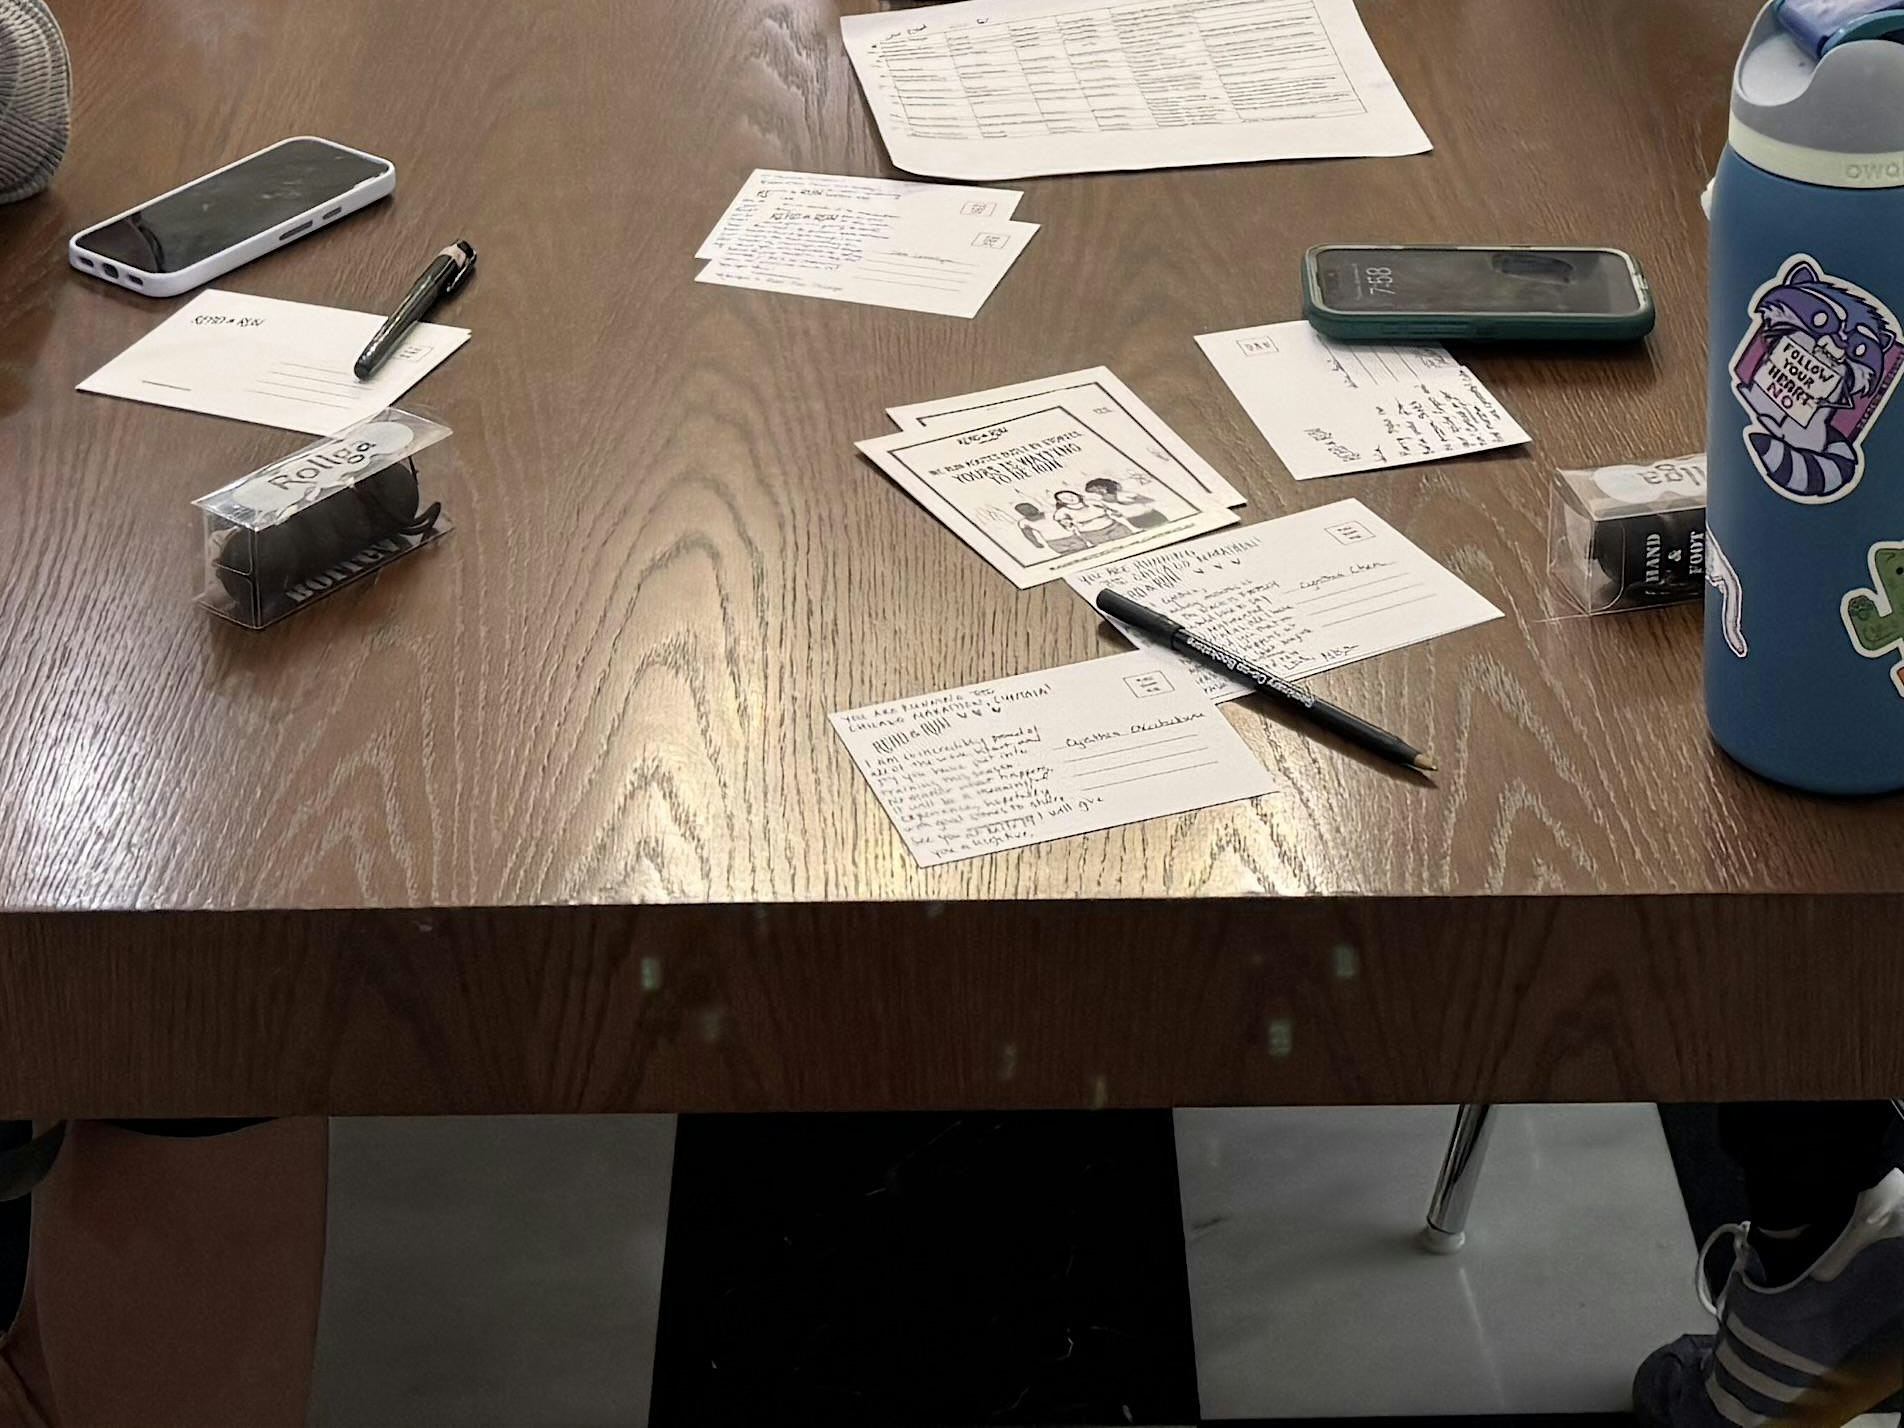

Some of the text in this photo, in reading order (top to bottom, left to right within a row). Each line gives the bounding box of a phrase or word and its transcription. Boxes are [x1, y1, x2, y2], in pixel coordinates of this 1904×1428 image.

[1366, 266, 1396, 295] 7:58
[1783, 343, 1835, 383] FOLLOW
[1783, 358, 1815, 390] YOUR
[1766, 382, 1794, 410] NO
[268, 442, 376, 490] Rollga
[951, 464, 1002, 485] YOURS
[1014, 443, 1082, 469] WAITING
[1645, 532, 1661, 584] HAND
[1668, 549, 1682, 562] &
[1689, 531, 1705, 575] FOOT
